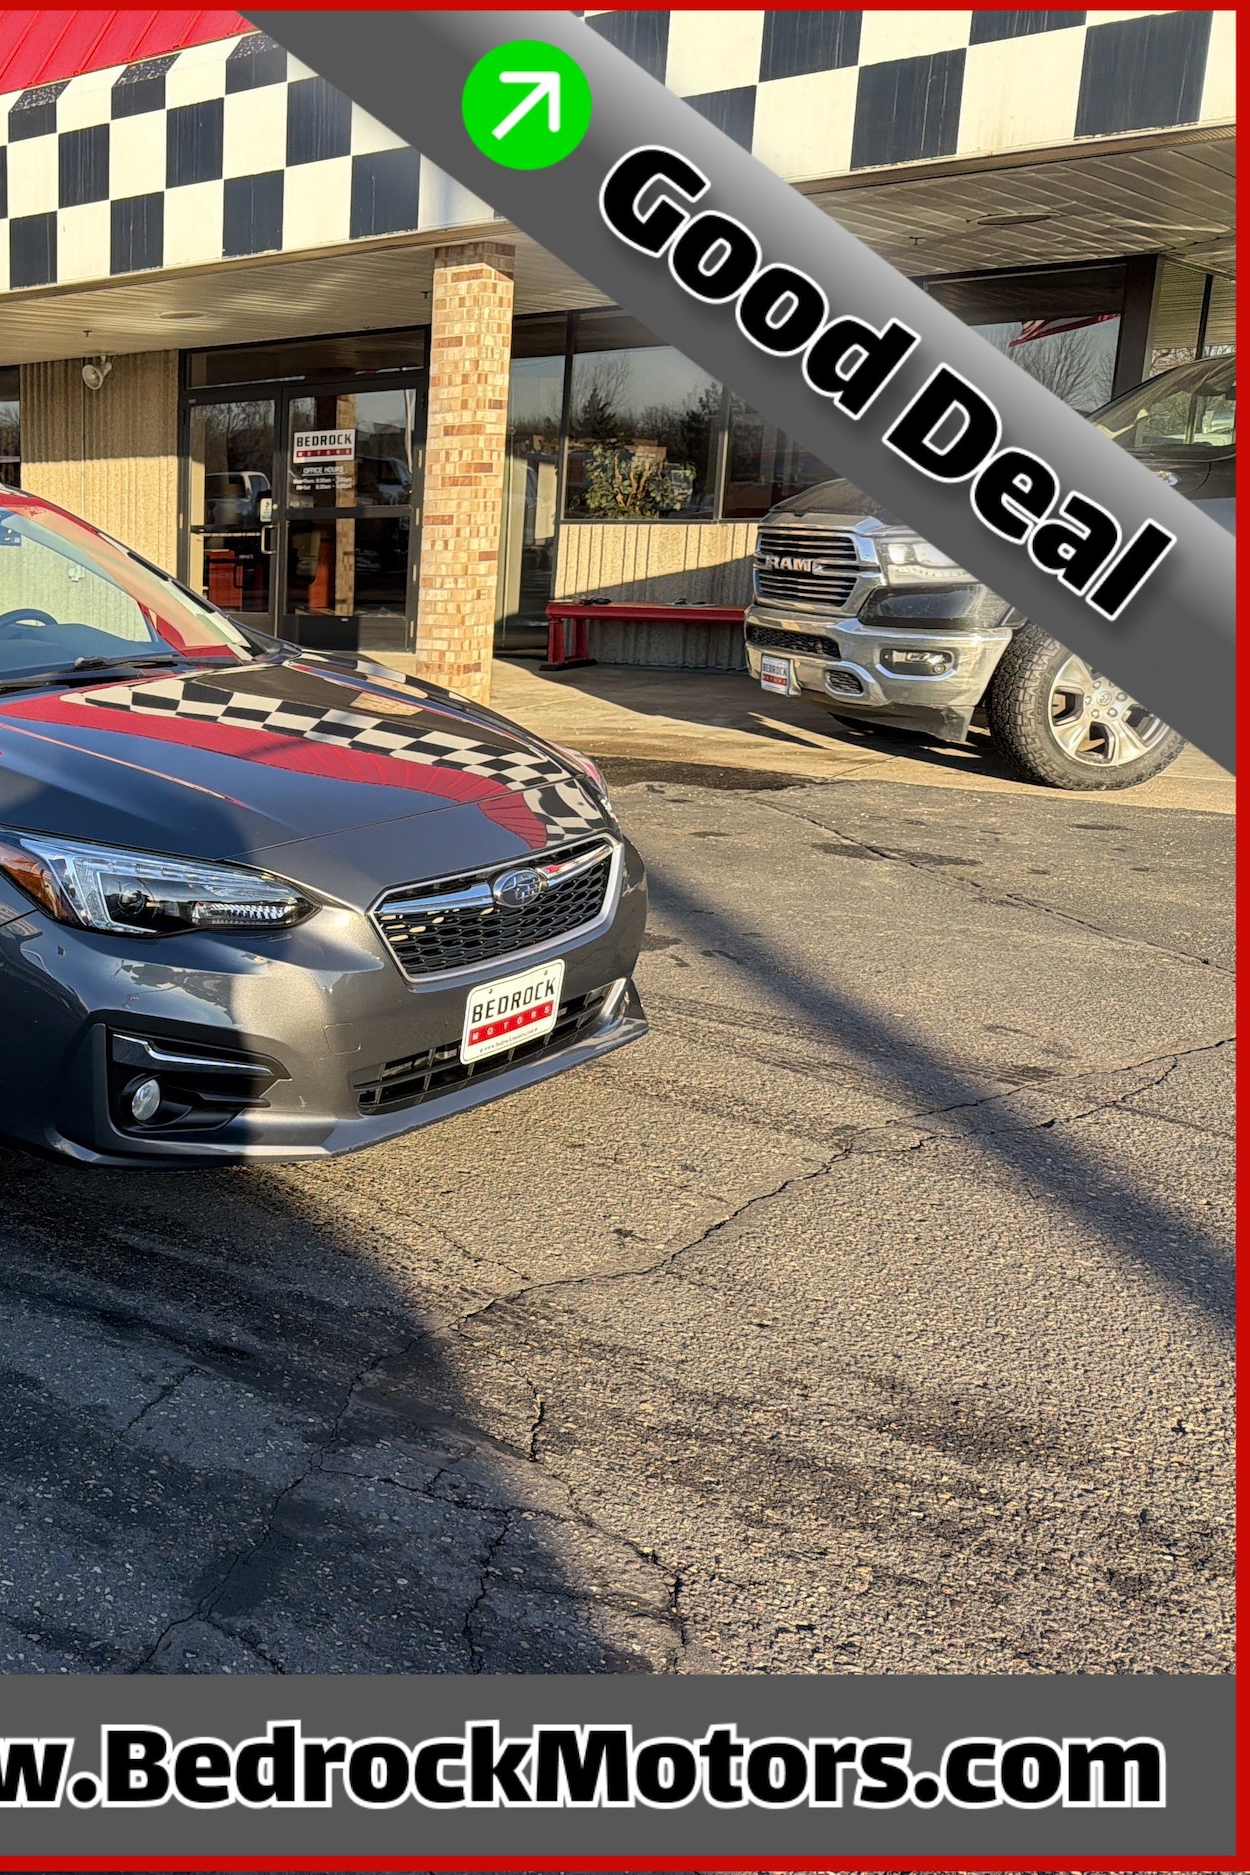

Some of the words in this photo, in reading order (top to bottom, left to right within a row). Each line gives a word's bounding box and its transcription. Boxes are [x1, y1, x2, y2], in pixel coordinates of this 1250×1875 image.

[296, 433, 352, 448] BEDROCK
[303, 466, 323, 474] OFFICE
[324, 465, 344, 473] HOURS
[765, 554, 812, 572] RAM
[471, 976, 557, 1024] BEDROCK
[471, 1005, 550, 1041] MOTORS
